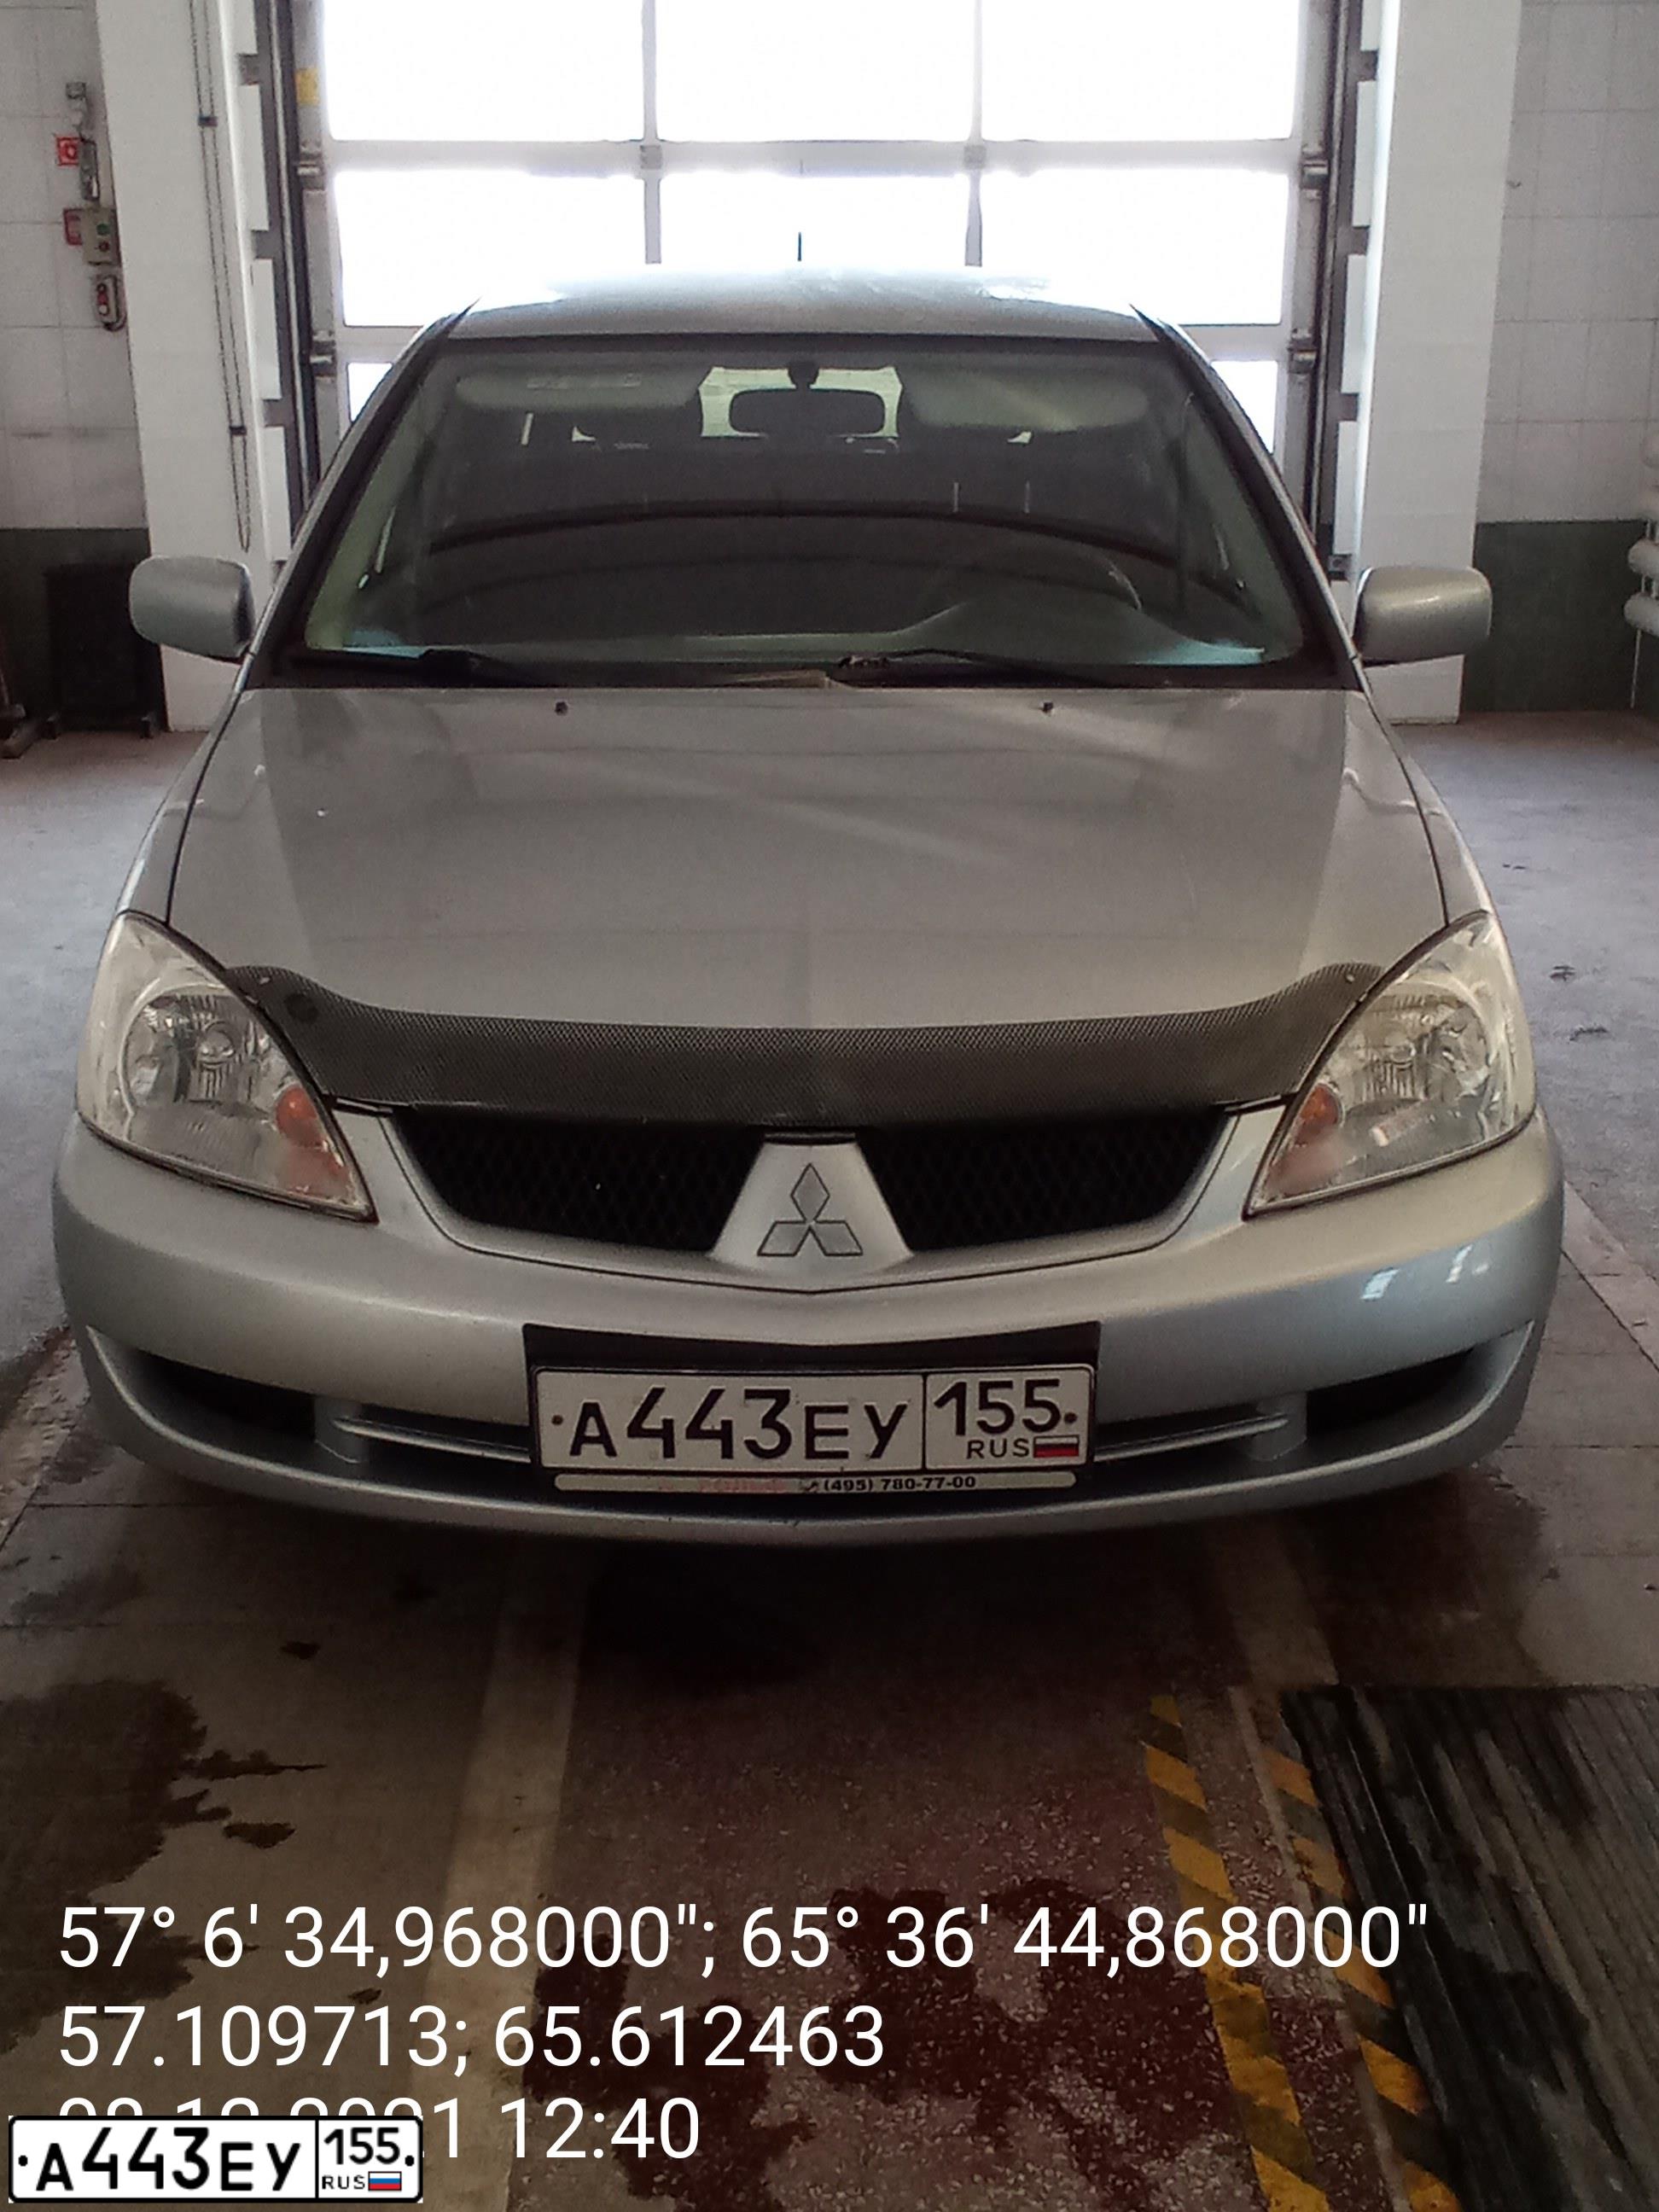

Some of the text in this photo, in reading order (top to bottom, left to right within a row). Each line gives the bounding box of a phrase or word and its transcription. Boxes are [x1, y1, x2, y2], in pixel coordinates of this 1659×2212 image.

[569, 1378, 1062, 1459] А443ЕУ 155
[966, 1438, 1030, 1459] RUS
[824, 1476, 976, 1492] (495) 780-77-00
